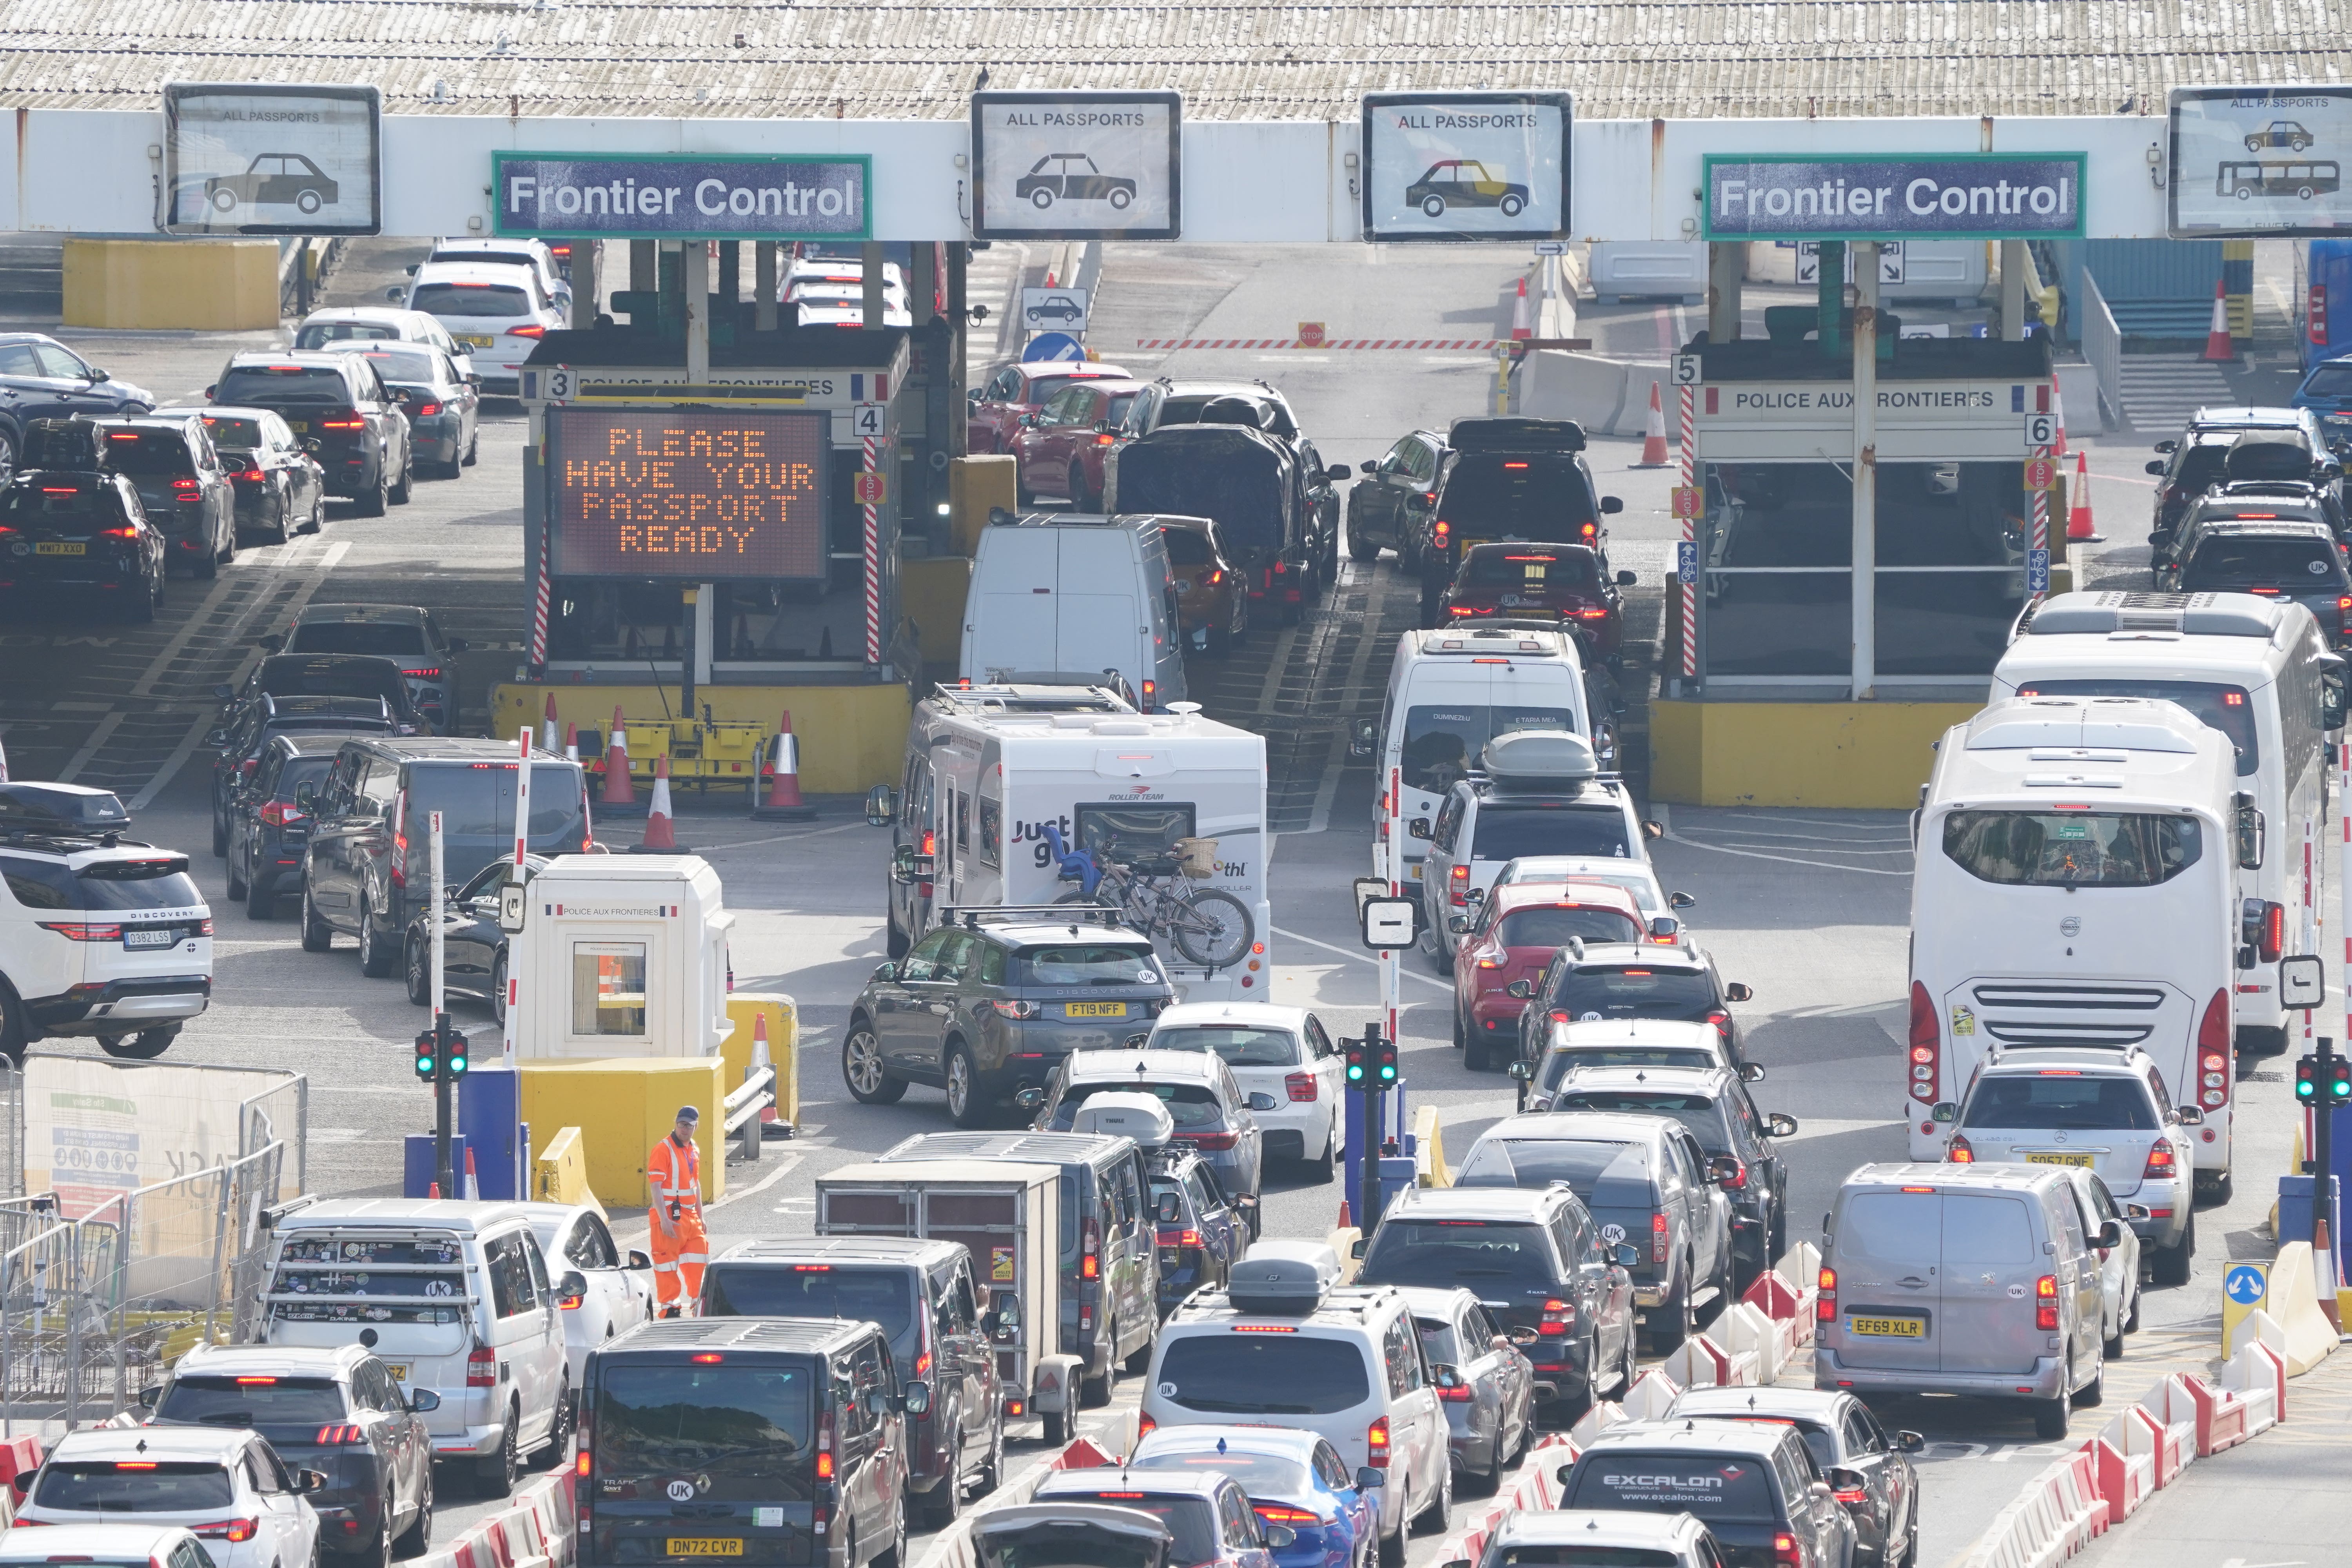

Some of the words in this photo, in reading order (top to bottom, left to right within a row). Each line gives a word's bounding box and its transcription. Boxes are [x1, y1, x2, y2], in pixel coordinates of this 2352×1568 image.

[2230, 98, 2255, 108] ALL
[2258, 98, 2329, 108] PASSPORTS
[223, 111, 246, 122] ALL
[250, 111, 319, 122] PASSPORTS
[1007, 113, 1038, 126] ALL
[1044, 113, 1144, 126] PASSPORTS
[1398, 114, 1430, 129] ALL
[1436, 114, 1537, 128] PASSPORTS
[510, 176, 681, 215] Frontier
[695, 179, 854, 216] Control
[1720, 179, 1891, 216] Frontier
[1906, 177, 2068, 215] Control
[1301, 331, 1323, 340] STOP
[1679, 358, 1695, 382] 5
[552, 373, 567, 396] 3
[1737, 393, 1810, 408] POLICE
[1817, 393, 1854, 408] AUX
[1877, 391, 1994, 408] RONTIERES
[860, 410, 878, 432] 4
[2032, 417, 2050, 442] 6
[609, 428, 767, 458] PLEASE
[566, 459, 675, 488] HAVE
[709, 462, 815, 491] YOUR
[2036, 462, 2045, 486] STOP
[866, 476, 875, 500] STOP
[583, 492, 798, 522] PASSPORT
[1683, 490, 1691, 515] STOP
[620, 524, 756, 554] READY
[14, 544, 29, 553] UK
[1503, 595, 1517, 604] UK
[1224, 862, 1245, 877] thl
[563, 907, 592, 916] POLICE
[612, 908, 659, 916] FRONTIERES
[131, 932, 151, 946] 0382
[154, 931, 171, 944] LSS
[1140, 973, 1156, 981] UK
[1072, 1004, 1096, 1014] FT19
[1099, 1004, 1119, 1014] NFF
[1605, 1227, 1622, 1240] UK
[429, 1284, 447, 1296] UK
[1857, 1319, 1889, 1332] EF69
[1893, 1321, 1917, 1334] XLR
[1161, 1385, 1173, 1395] UK
[1603, 1475, 1722, 1487] EXCALON
[671, 1485, 690, 1498] UK
[1622, 1494, 1722, 1503] www.excalon.com
[673, 1539, 707, 1554] DN72
[711, 1540, 737, 1554] CVR
